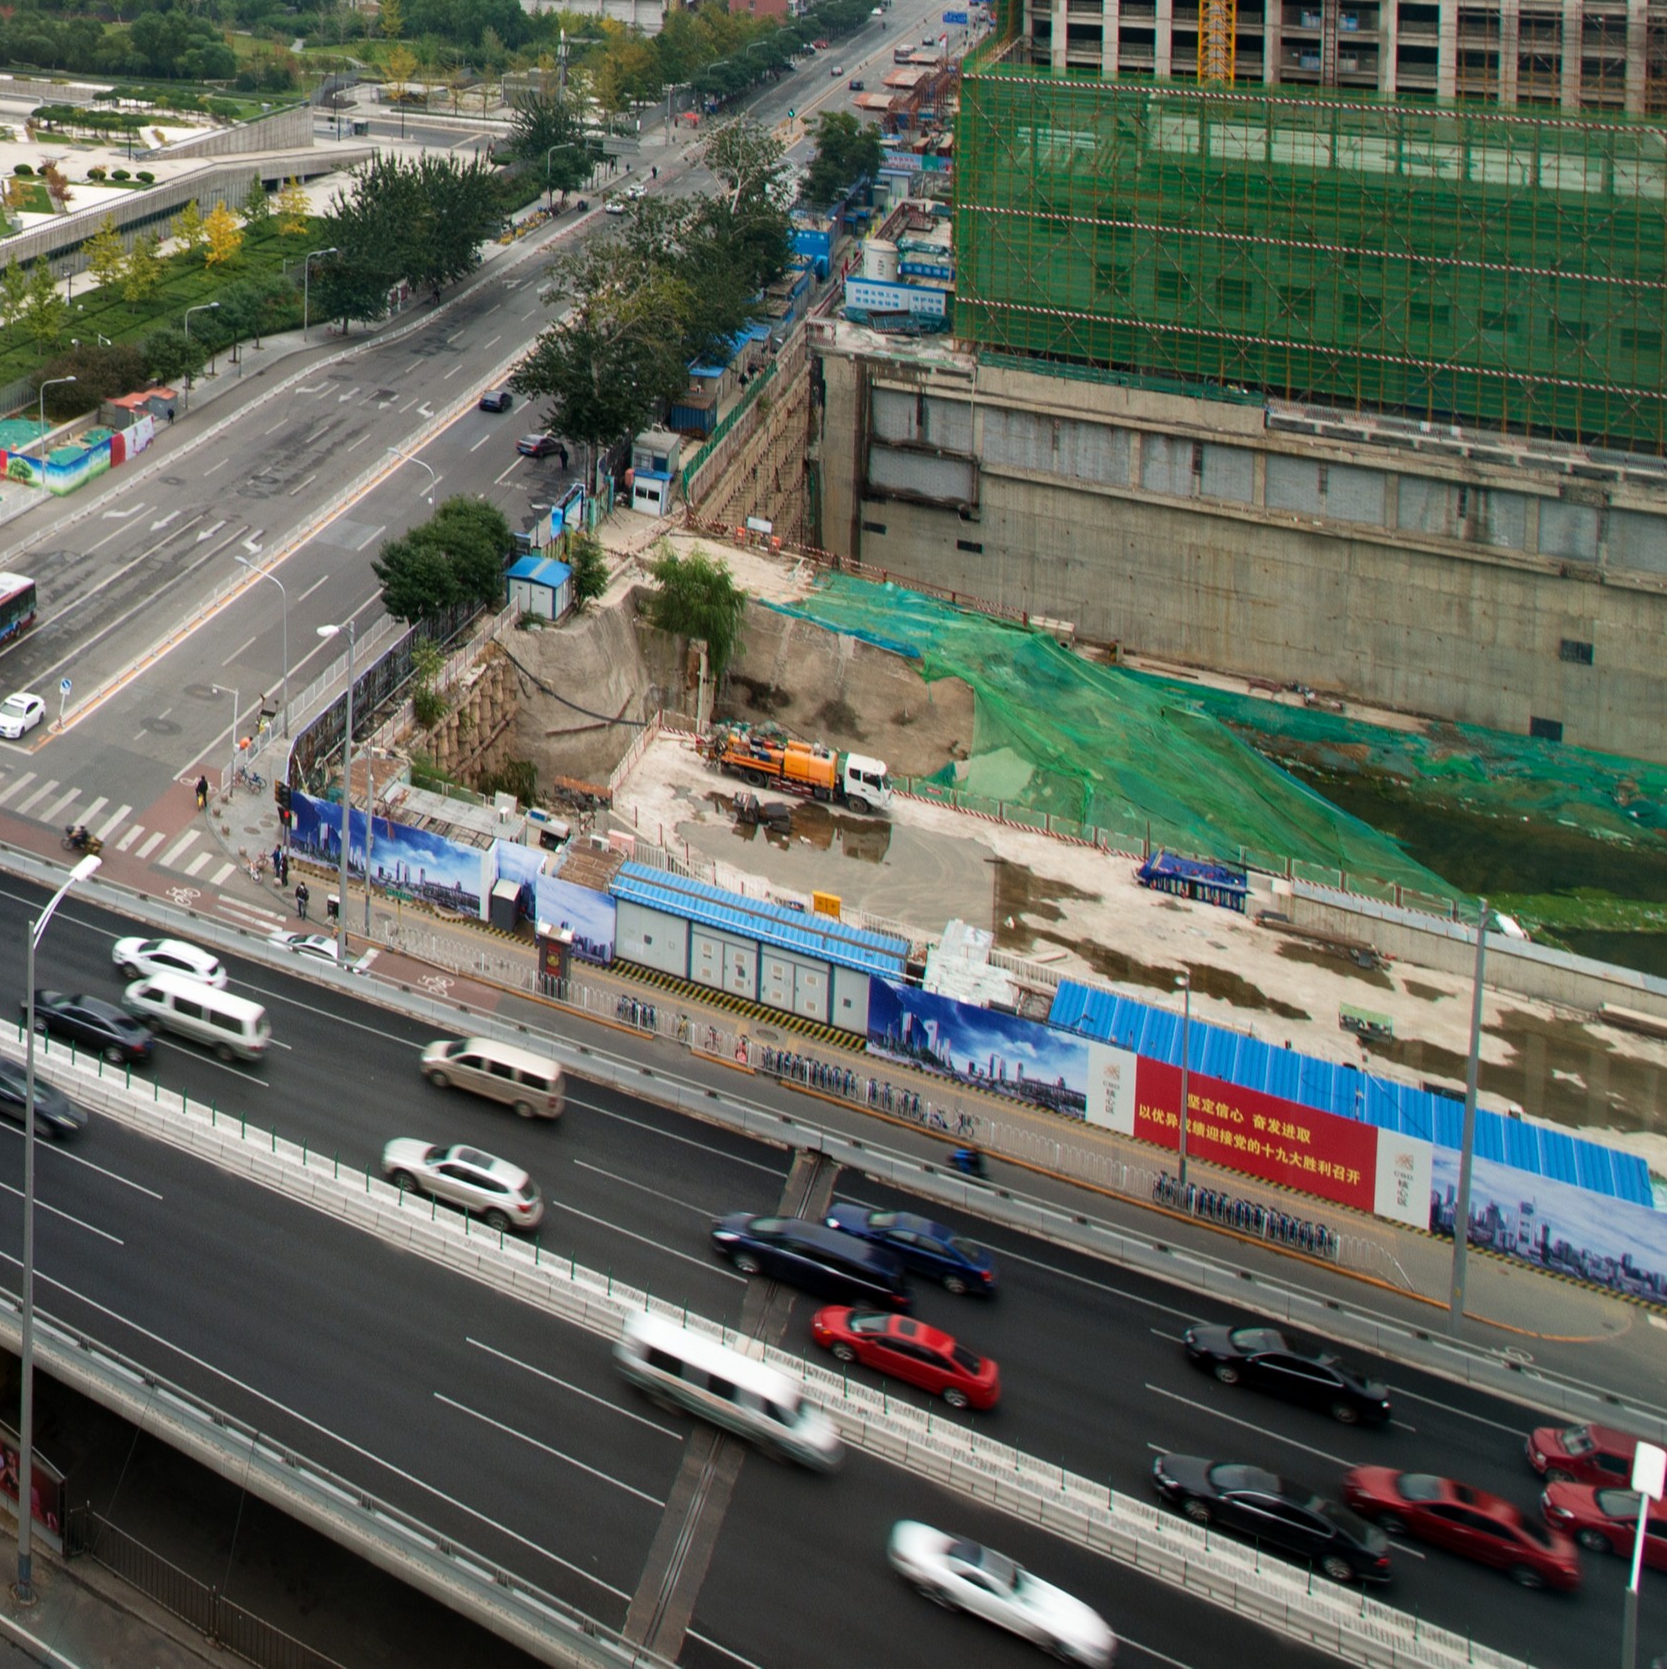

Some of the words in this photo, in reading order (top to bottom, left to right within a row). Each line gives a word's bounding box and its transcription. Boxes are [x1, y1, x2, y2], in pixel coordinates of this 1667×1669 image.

[1187, 1094, 1244, 1123] 坚定信心
[1252, 1113, 1311, 1144] 奋发进取
